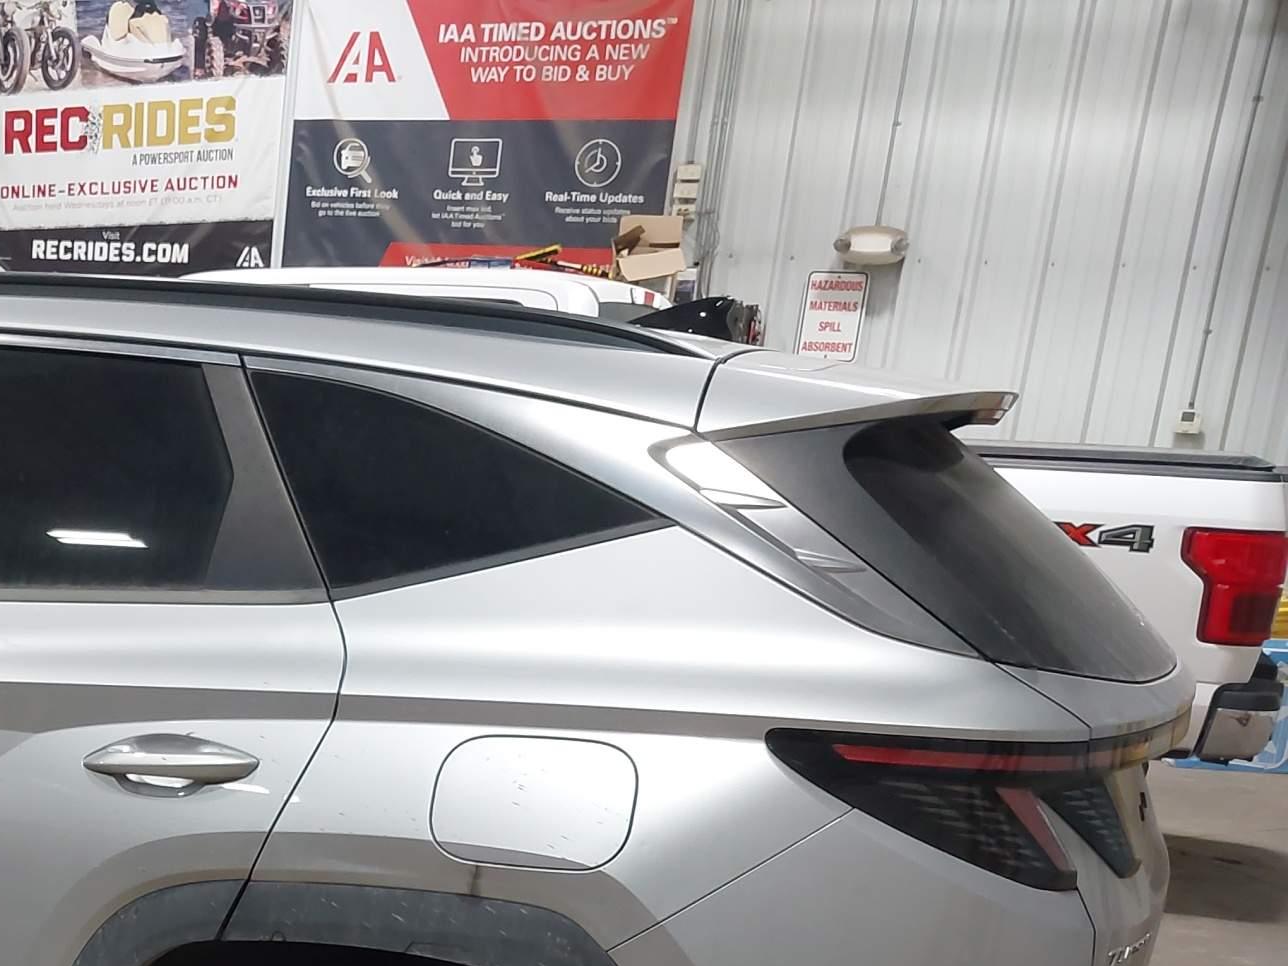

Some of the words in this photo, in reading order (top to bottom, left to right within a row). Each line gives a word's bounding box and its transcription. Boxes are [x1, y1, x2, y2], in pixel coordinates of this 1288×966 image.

[438, 23, 476, 43] IAA
[481, 21, 544, 42] TIMED
[460, 45, 582, 63] INTRODUCING
[586, 45, 599, 61] A
[605, 43, 650, 60] NEW
[471, 66, 509, 83] WAY
[514, 65, 536, 82] TO
[542, 65, 571, 82] BID
[575, 65, 589, 82] &
[595, 64, 635, 81] BUY
[4, 106, 89, 155] REC
[102, 96, 237, 149] RIDES
[132, 154, 137, 166] A
[139, 151, 194, 165] POWERSPORT
[197, 148, 233, 162] AUCTION
[0, 179, 159, 199] ONLINE-EXCLUSIVE
[164, 175, 239, 192] AUCTION
[306, 186, 348, 198] Exclusive
[350, 187, 371, 198] First
[374, 188, 399, 199] Look
[433, 189, 462, 200] Quick
[464, 191, 483, 200] and
[485, 190, 509, 203] Easy
[545, 191, 597, 202] Real-Time
[599, 192, 644, 204] Updates
[102, 231, 120, 240] Visit
[32, 239, 189, 264] RECRIDES.COM
[811, 279, 864, 292] HAZARDOUS
[809, 300, 858, 312] MATERIALS
[818, 321, 842, 332] SPILL
[802, 341, 853, 353] ABSORBENT
